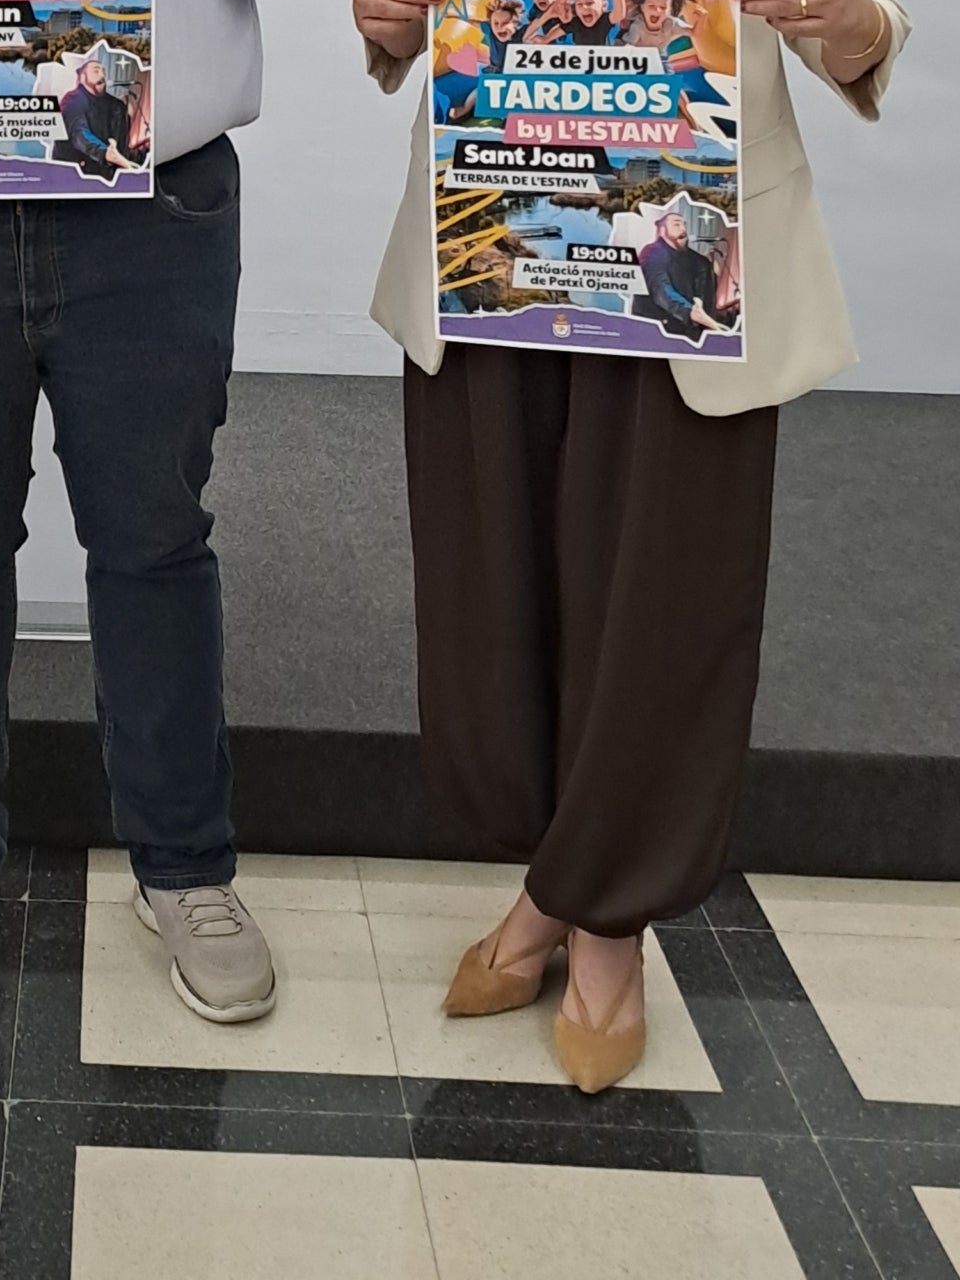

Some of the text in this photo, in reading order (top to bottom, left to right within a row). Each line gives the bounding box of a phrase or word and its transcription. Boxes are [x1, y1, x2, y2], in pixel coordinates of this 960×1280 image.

[515, 49, 648, 75] 24 de juny
[42, 97, 54, 110] h
[484, 79, 672, 114] TARDEOS
[7, 116, 57, 127] musical
[10, 128, 50, 139] Ojana
[517, 119, 553, 144] by
[464, 143, 595, 169] Sant Joan
[453, 173, 509, 185] TERRASA
[512, 176, 529, 186] DE
[572, 246, 633, 263] 19:00 h
[582, 268, 636, 280] musical
[530, 276, 629, 291] de Patxi Ojana
